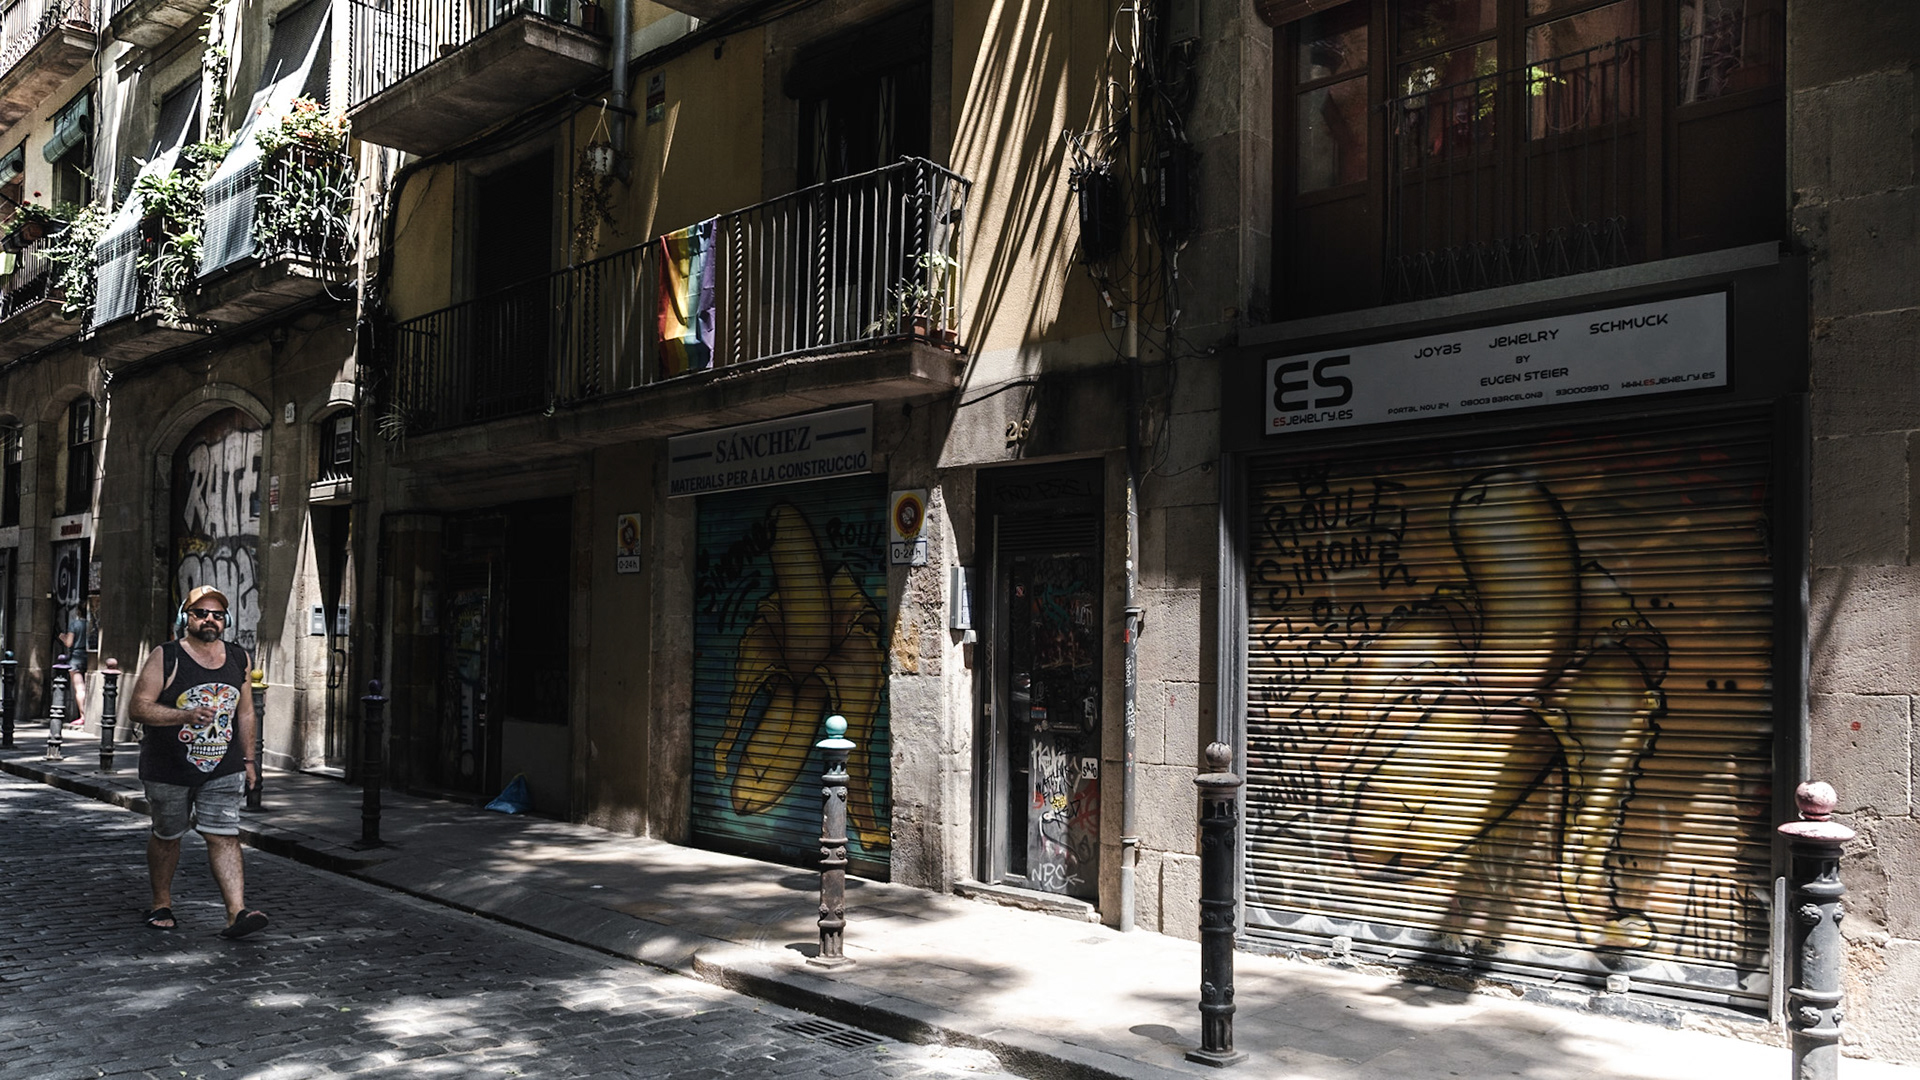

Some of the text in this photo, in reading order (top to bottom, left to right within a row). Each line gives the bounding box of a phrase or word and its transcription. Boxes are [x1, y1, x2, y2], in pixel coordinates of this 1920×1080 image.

[1589, 313, 1669, 335] SCHMUCK
[1515, 354, 1531, 364] BY
[1273, 354, 1353, 412] ES
[1480, 367, 1569, 387] EUGEN STEIER
[1438, 402, 1450, 410] 24
[1460, 397, 1490, 407] 08003
[1555, 384, 1609, 397] 930009910
[1007, 419, 1030, 441] 26
[715, 426, 811, 464] SÁNCHEZ
[670, 451, 867, 494] MATERIALS PER A LA CONSTRUCCIÓ
